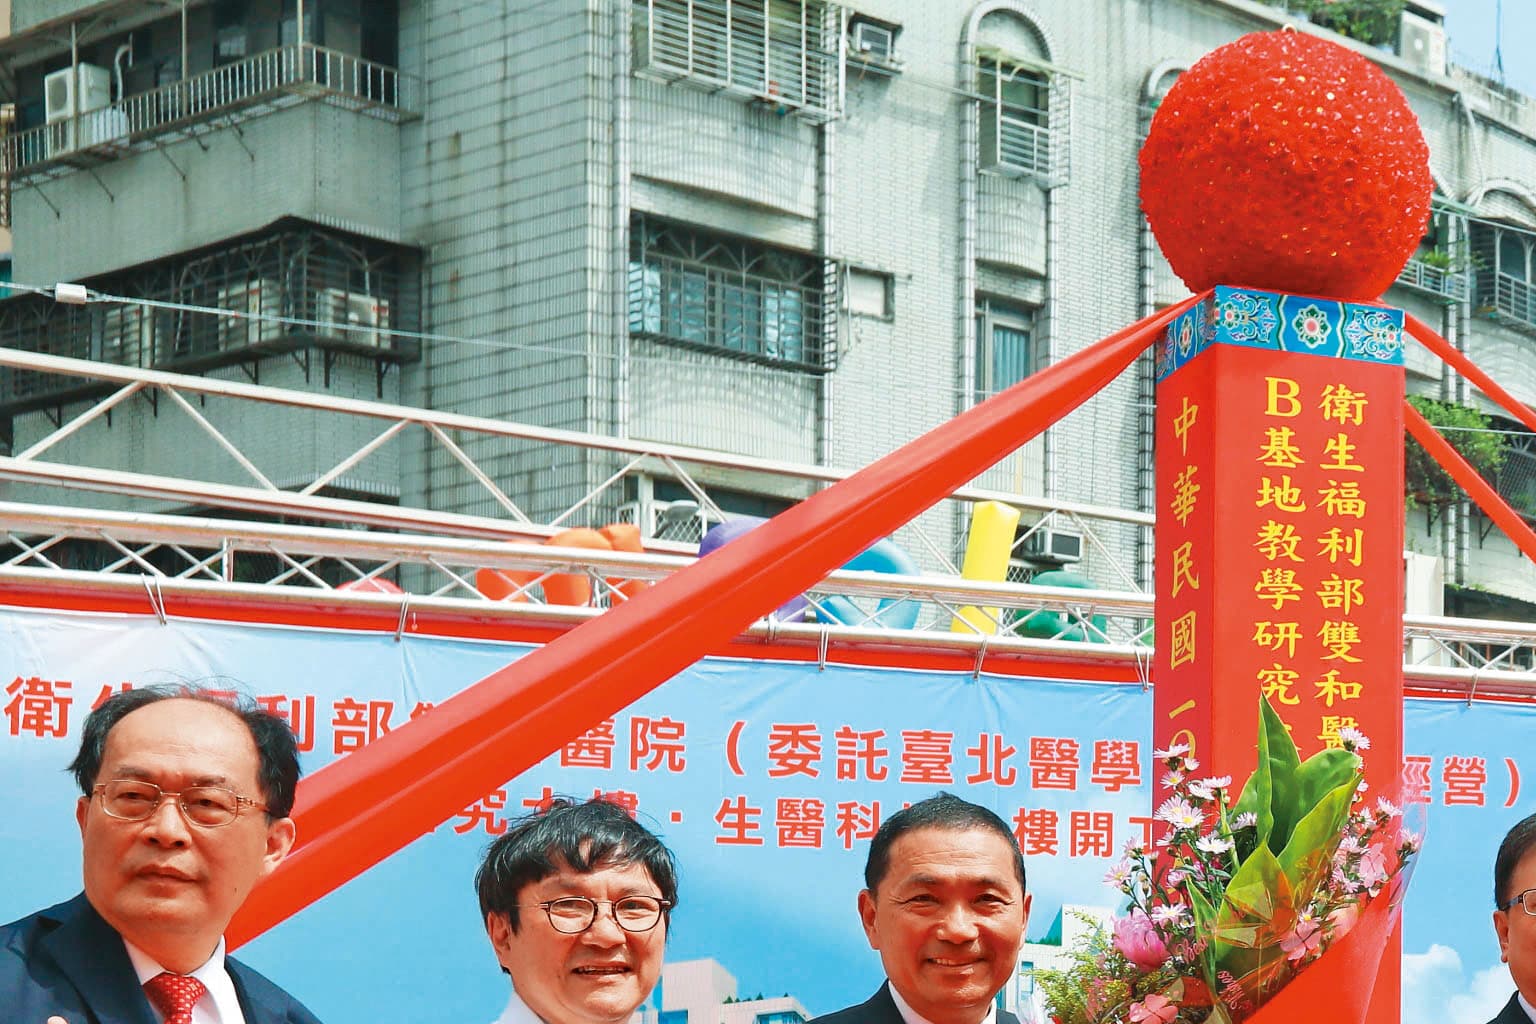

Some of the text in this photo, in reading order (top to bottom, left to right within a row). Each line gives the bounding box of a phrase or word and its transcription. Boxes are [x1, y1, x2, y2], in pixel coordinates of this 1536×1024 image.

[1254, 376, 1306, 771] B基地教學研究
